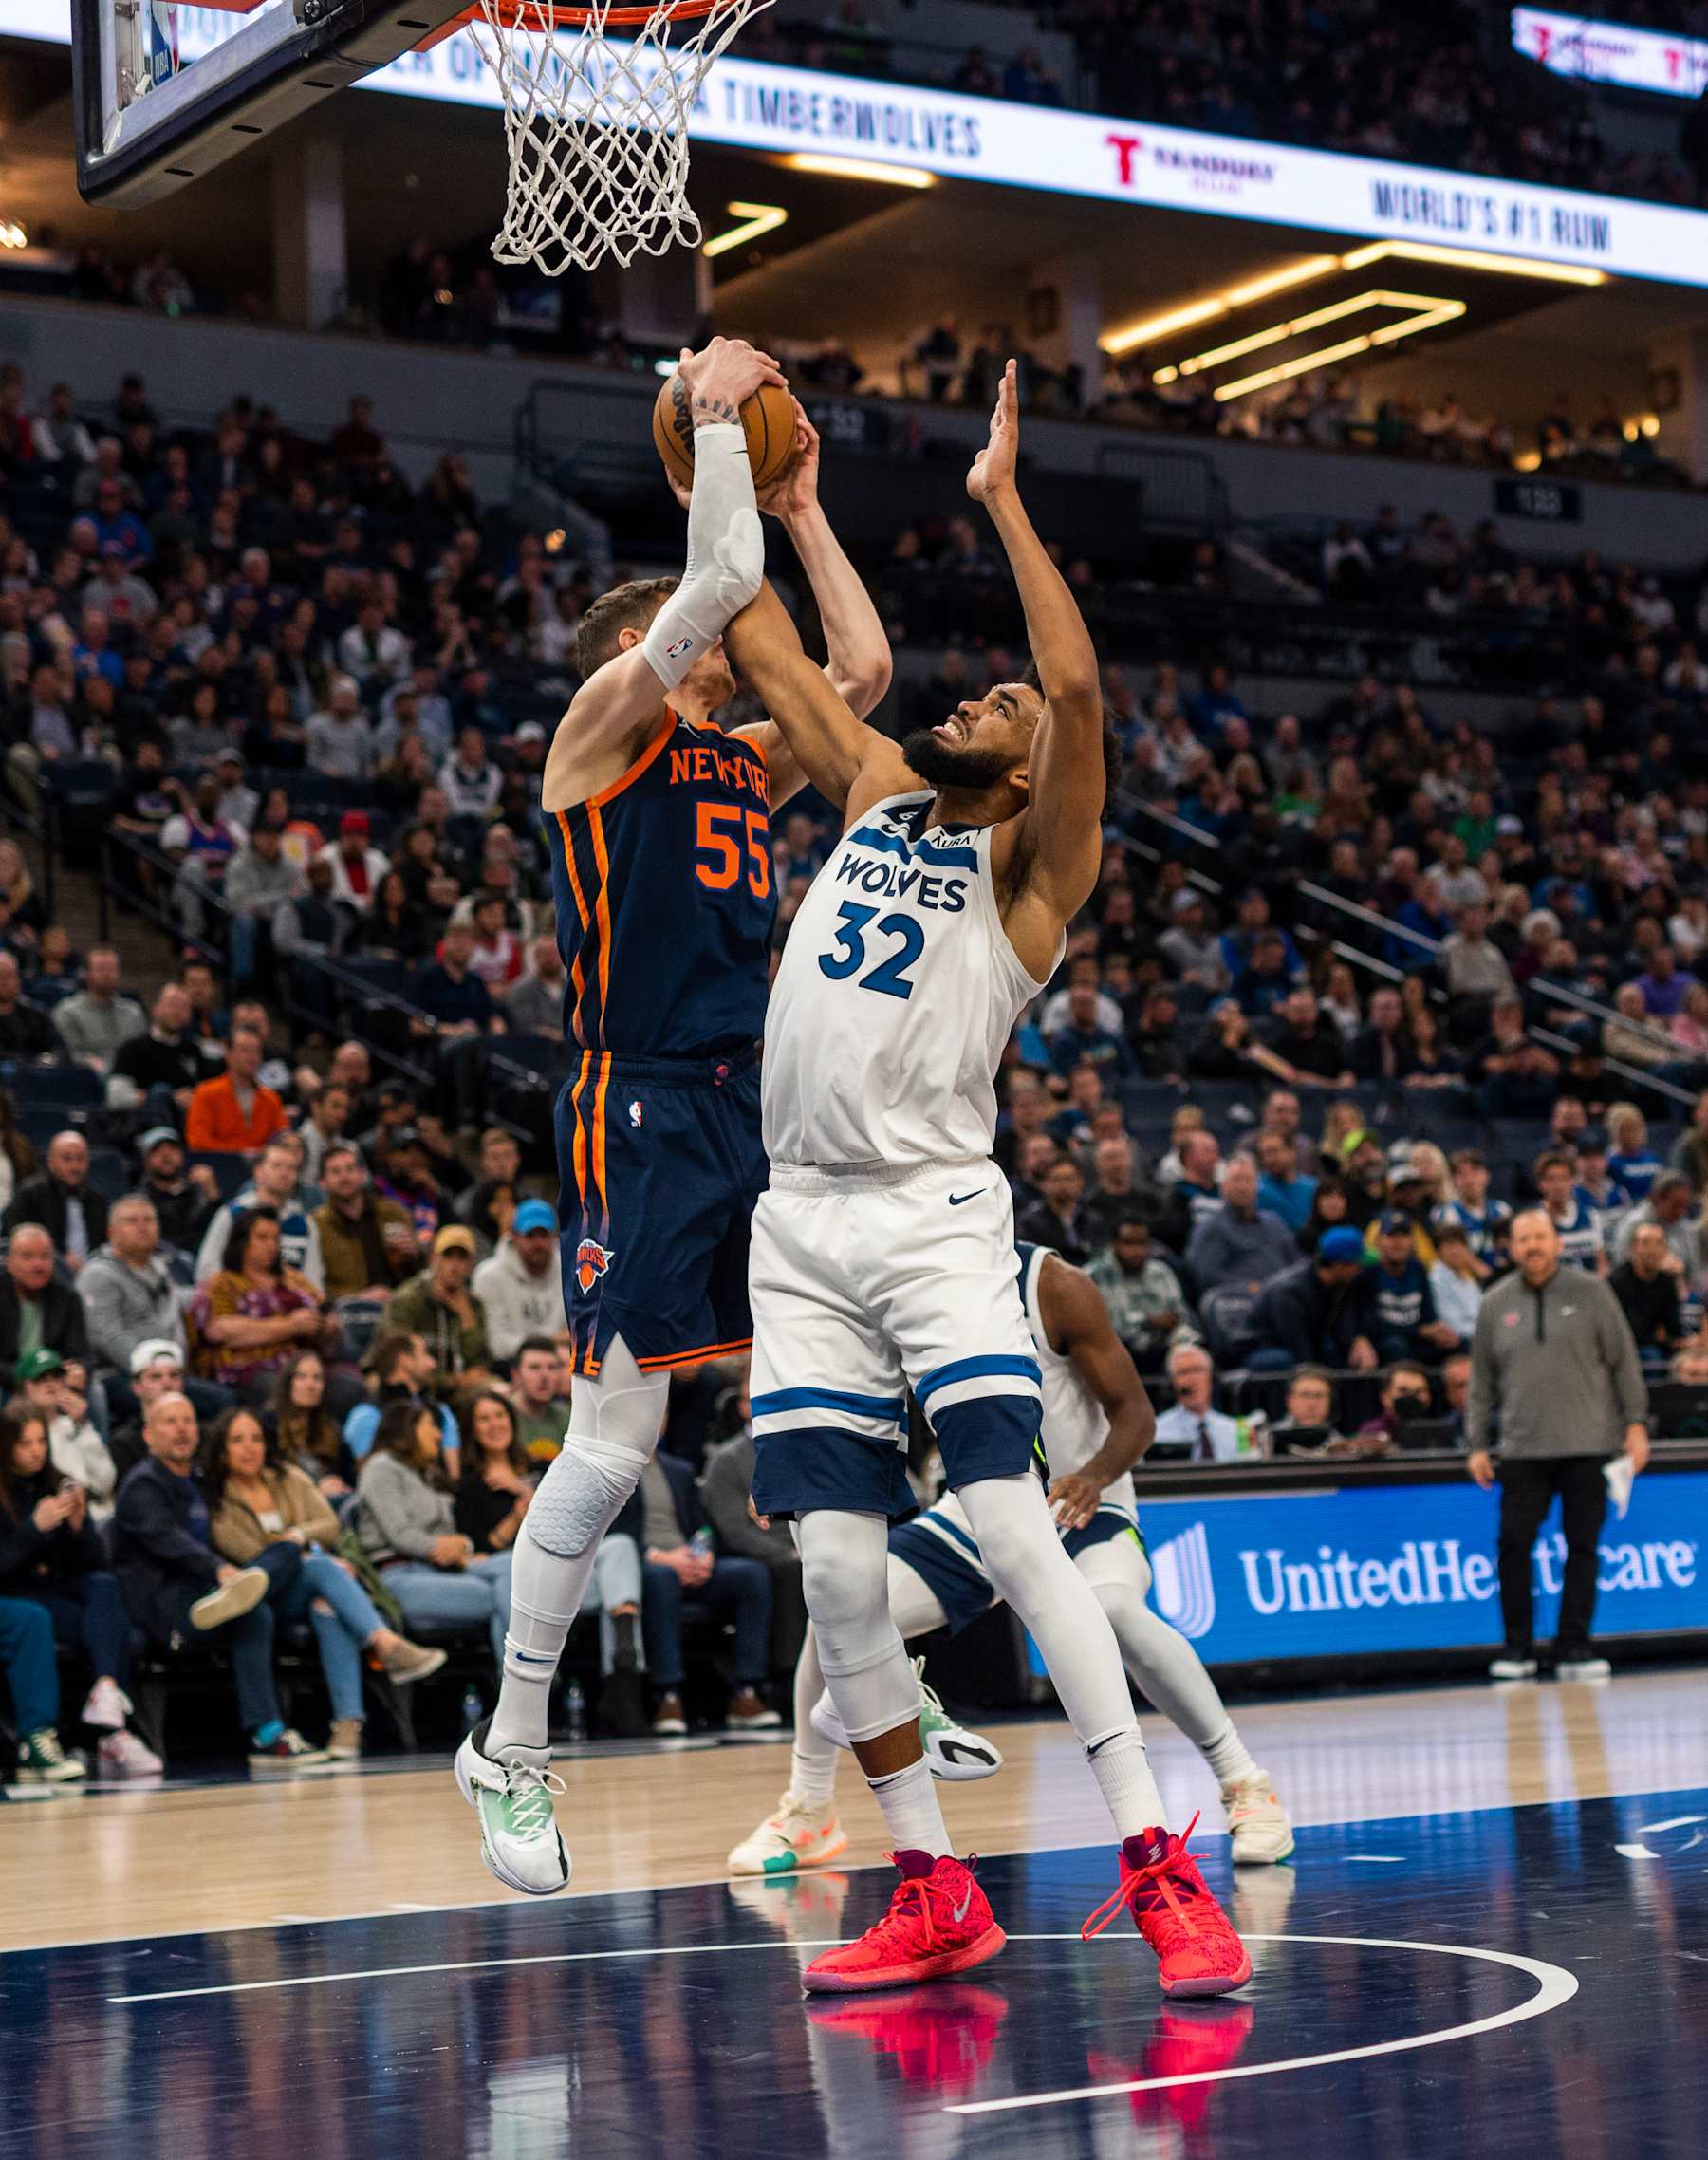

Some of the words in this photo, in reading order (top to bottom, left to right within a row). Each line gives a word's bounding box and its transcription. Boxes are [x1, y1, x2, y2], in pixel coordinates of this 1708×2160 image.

[724, 79, 982, 158] TIMBERWOLVES
[1371, 179, 1499, 235] WORLD'S
[721, 756, 770, 808] YOR
[694, 800, 771, 902] 55
[834, 853, 969, 913] WOLVES
[818, 899, 926, 1000] 32
